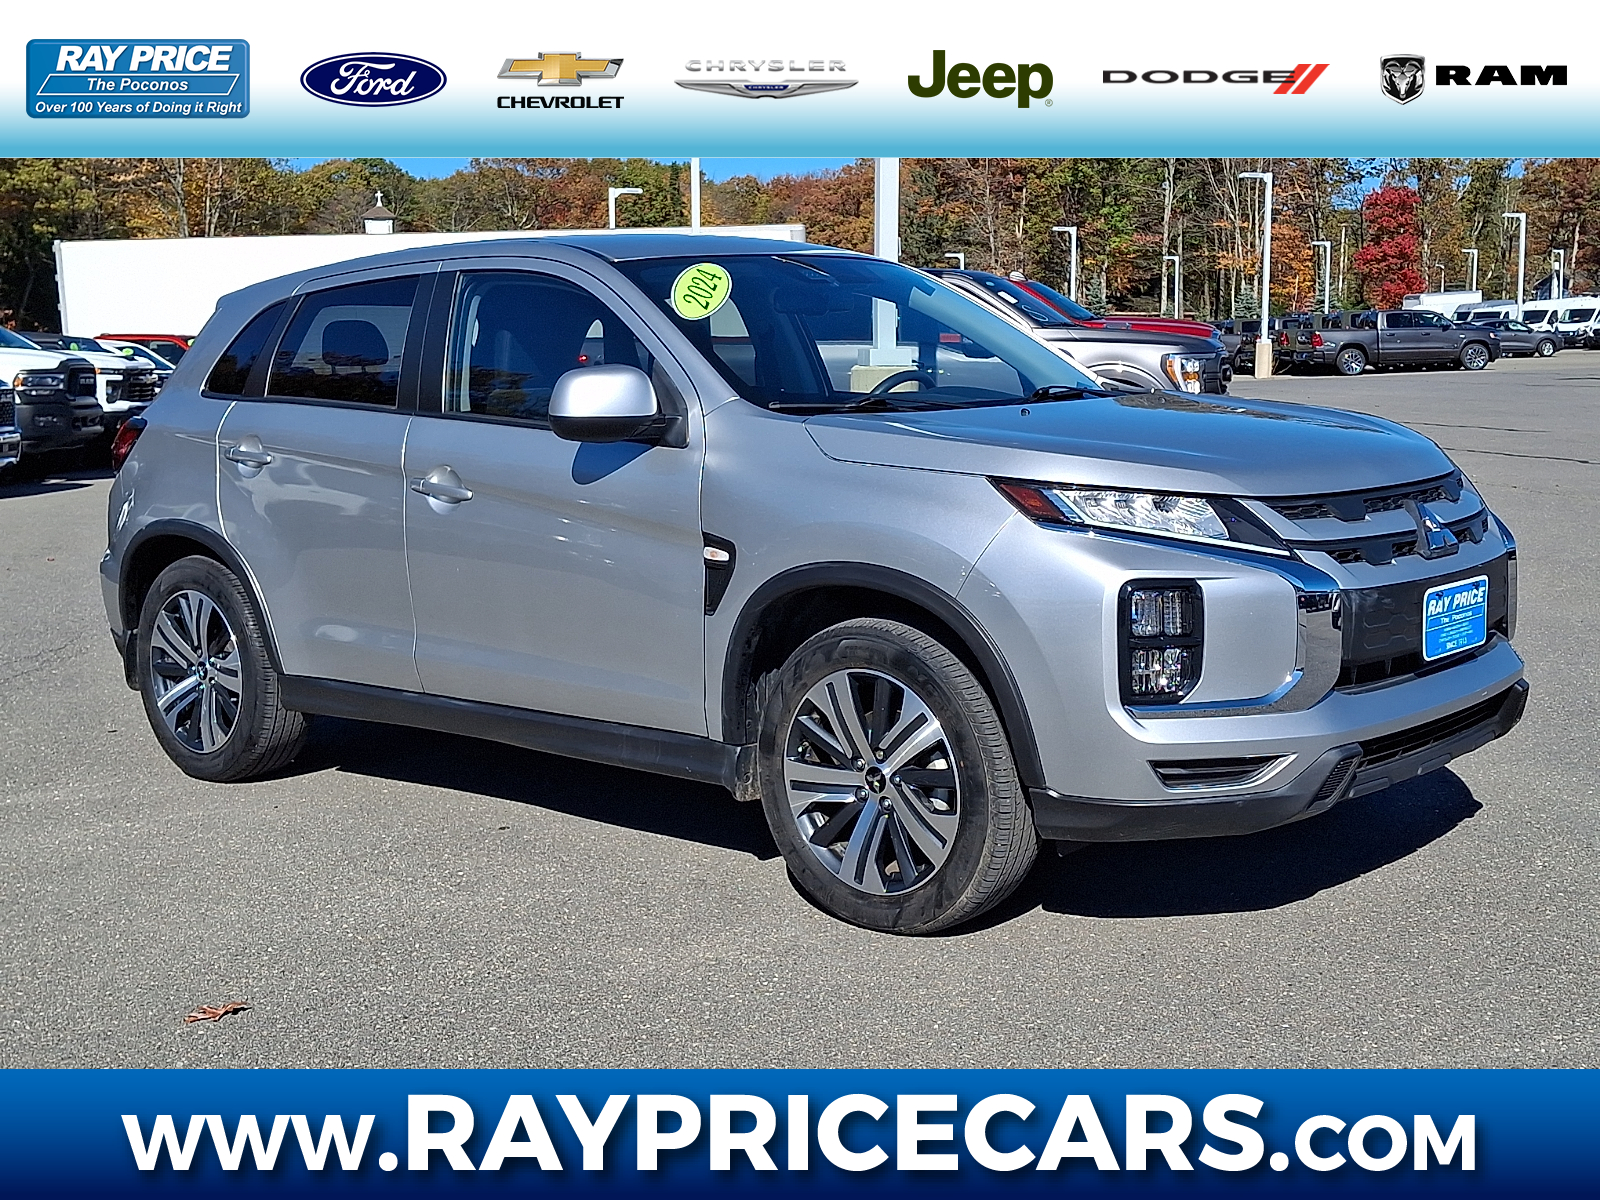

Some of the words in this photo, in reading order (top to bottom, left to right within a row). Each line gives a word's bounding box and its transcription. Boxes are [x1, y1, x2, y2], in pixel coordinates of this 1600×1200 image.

[683, 268, 722, 310] 2024
[1427, 595, 1452, 617] RAY
[1453, 587, 1486, 610] PRICE
